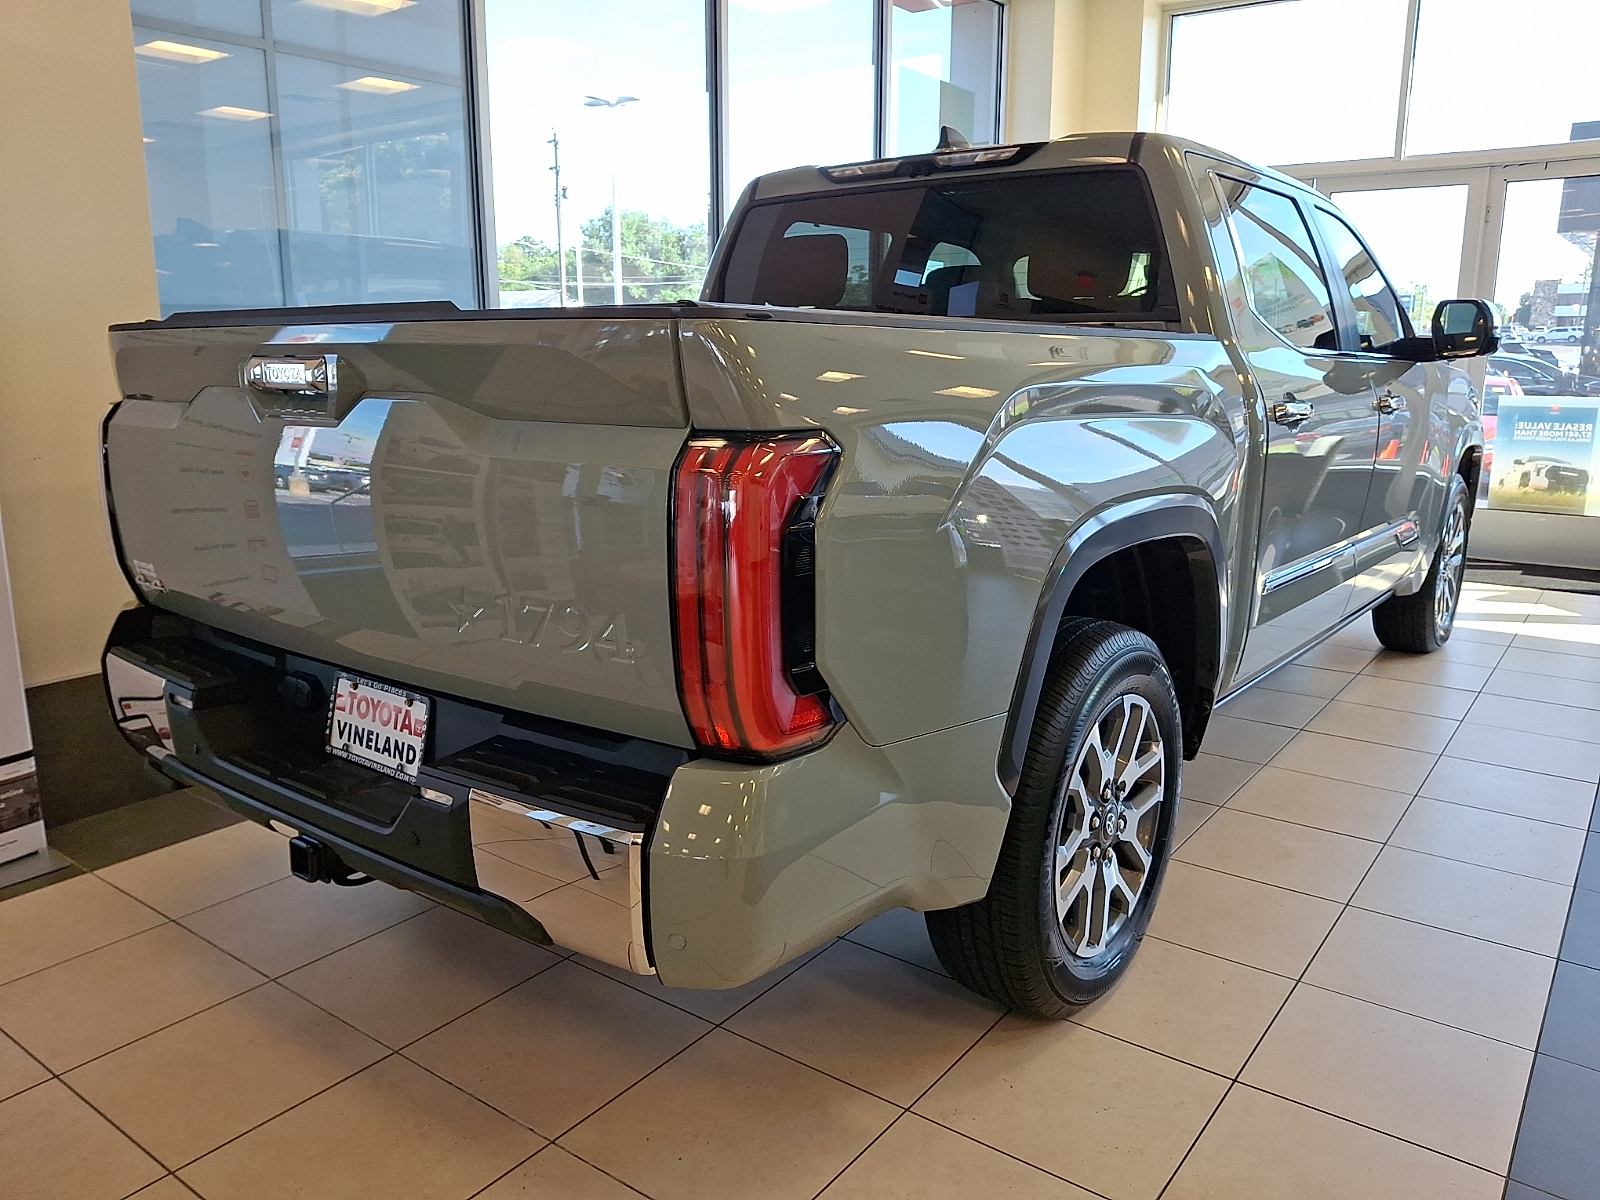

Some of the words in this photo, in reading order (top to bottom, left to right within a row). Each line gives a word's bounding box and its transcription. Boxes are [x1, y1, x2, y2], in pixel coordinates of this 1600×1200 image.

[265, 366, 303, 380] TOYOTA
[495, 592, 635, 664] 1794
[357, 677, 372, 687] Let's
[373, 681, 382, 690] Go
[384, 685, 407, 697] Places
[348, 690, 413, 736] TOYOTA
[337, 719, 417, 765] VINELAND
[332, 747, 409, 782] WWW.TOYOTAVINELAND.COM
